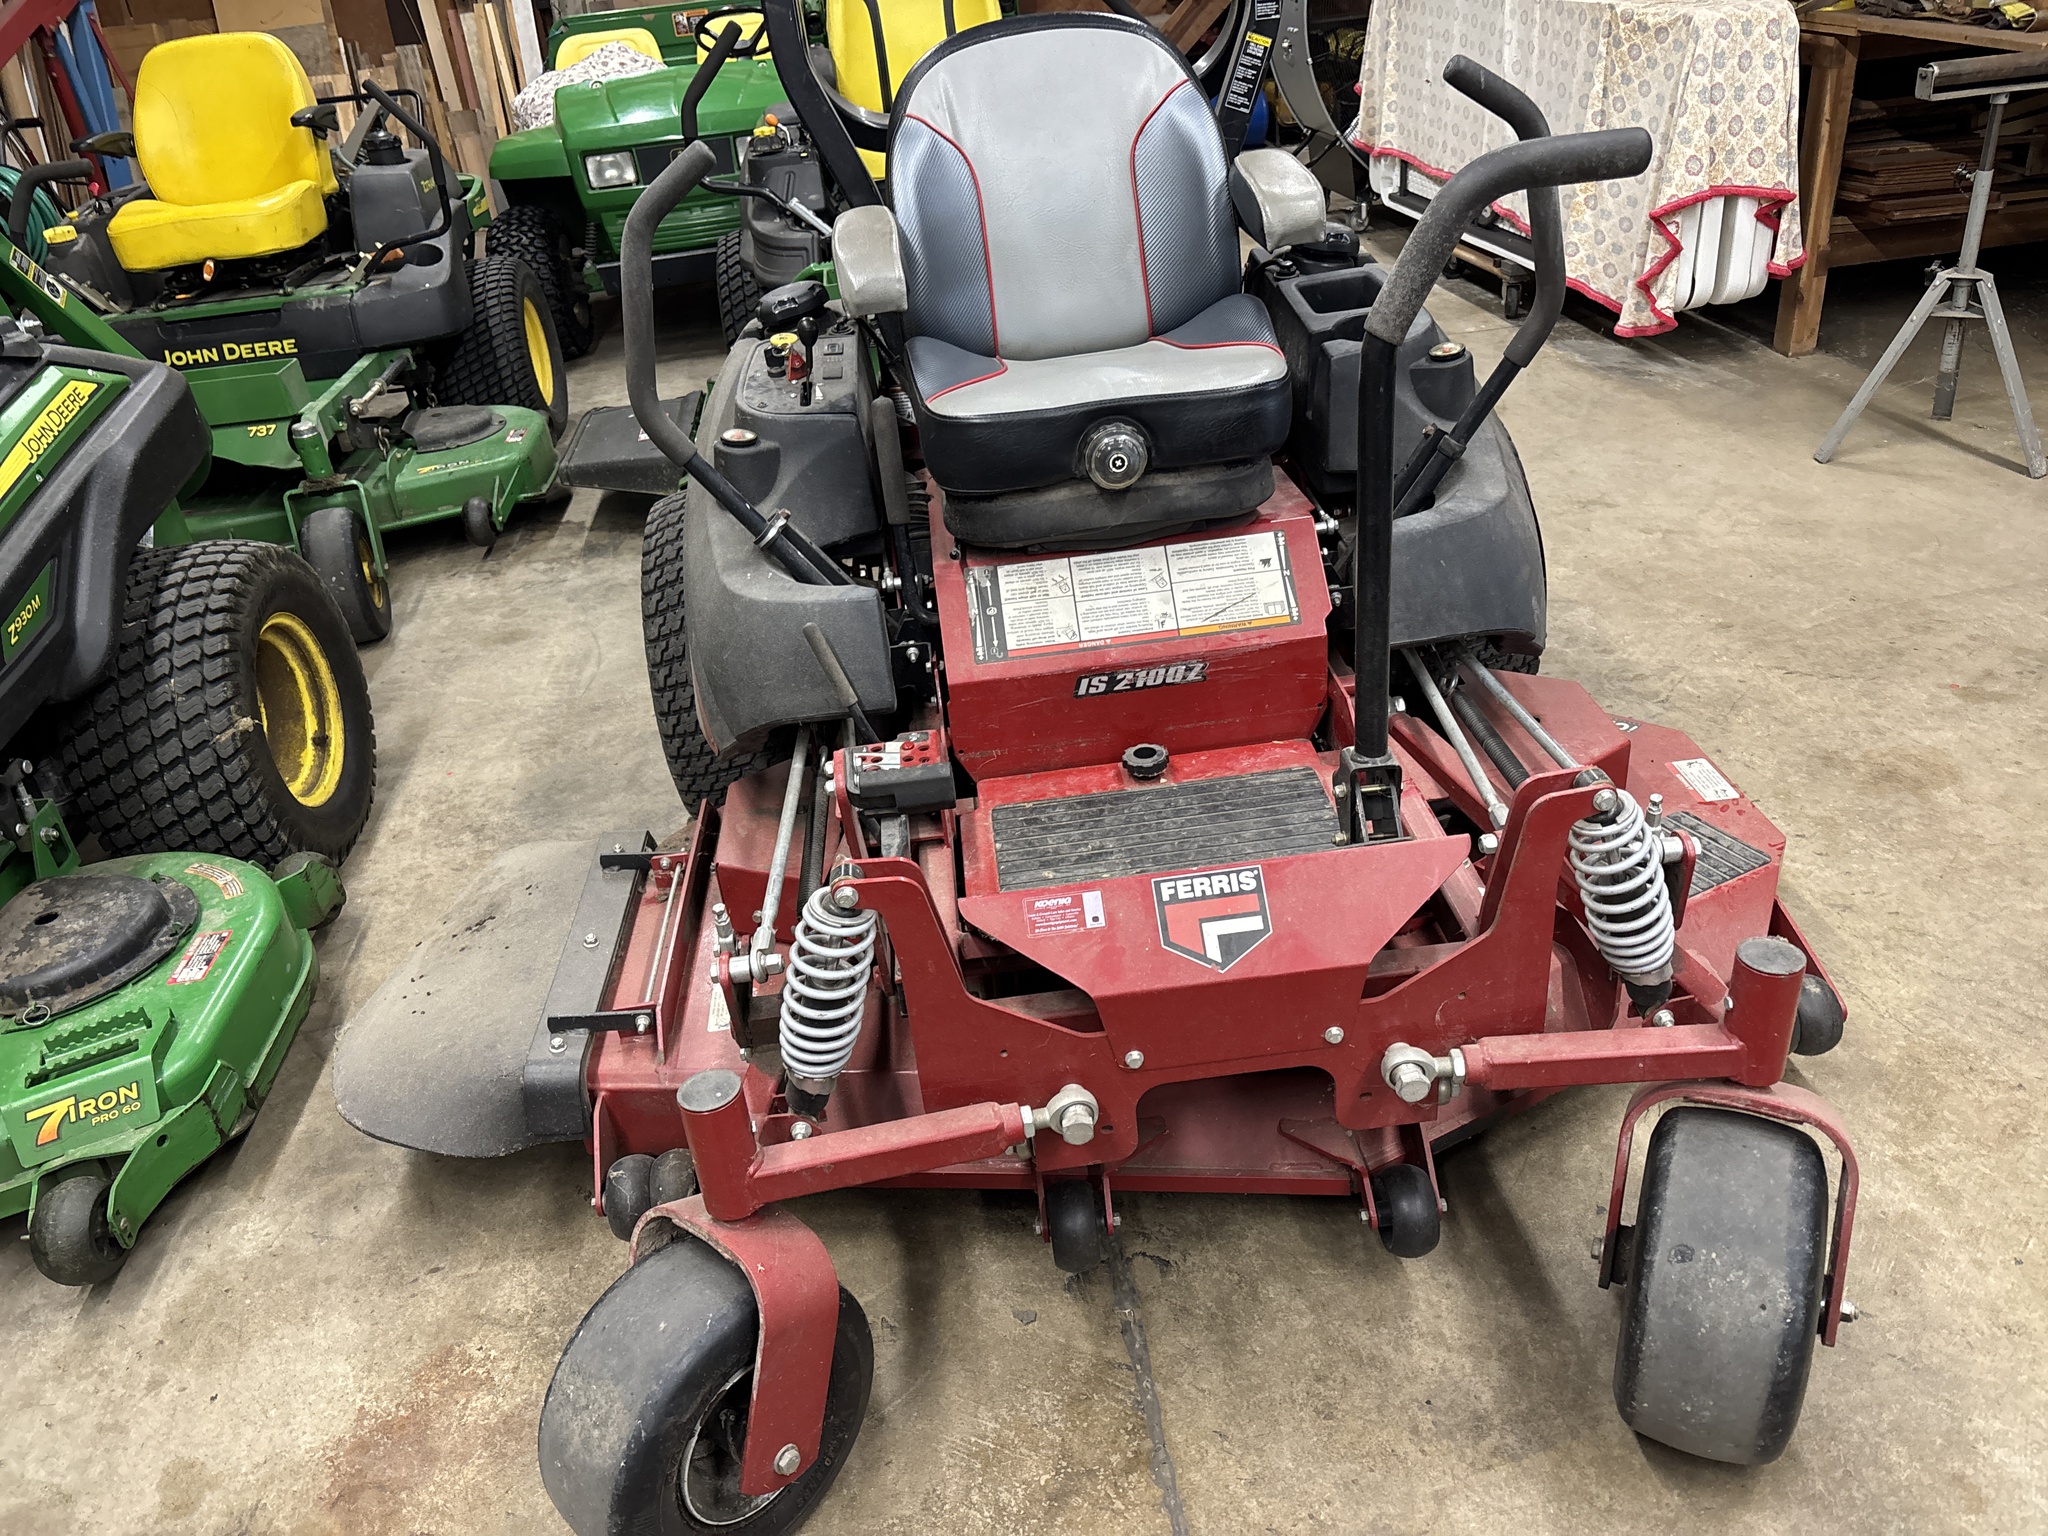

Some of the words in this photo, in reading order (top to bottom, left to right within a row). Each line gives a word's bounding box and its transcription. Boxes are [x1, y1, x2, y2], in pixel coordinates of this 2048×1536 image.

[163, 347, 219, 367] JOHN
[222, 338, 299, 361] DEERE
[21, 420, 57, 461] JOHN
[46, 386, 86, 429] DEERE
[247, 423, 277, 438] 737
[7, 594, 41, 647] Z930M
[1078, 639, 1104, 647] DANGER
[1077, 674, 1110, 696] IS
[1112, 662, 1205, 691] 2100Z
[1160, 869, 1258, 902] FERRIS
[25, 1081, 140, 1147] 7IRON
[91, 1109, 120, 1128] PRO
[121, 1101, 142, 1116] 60
